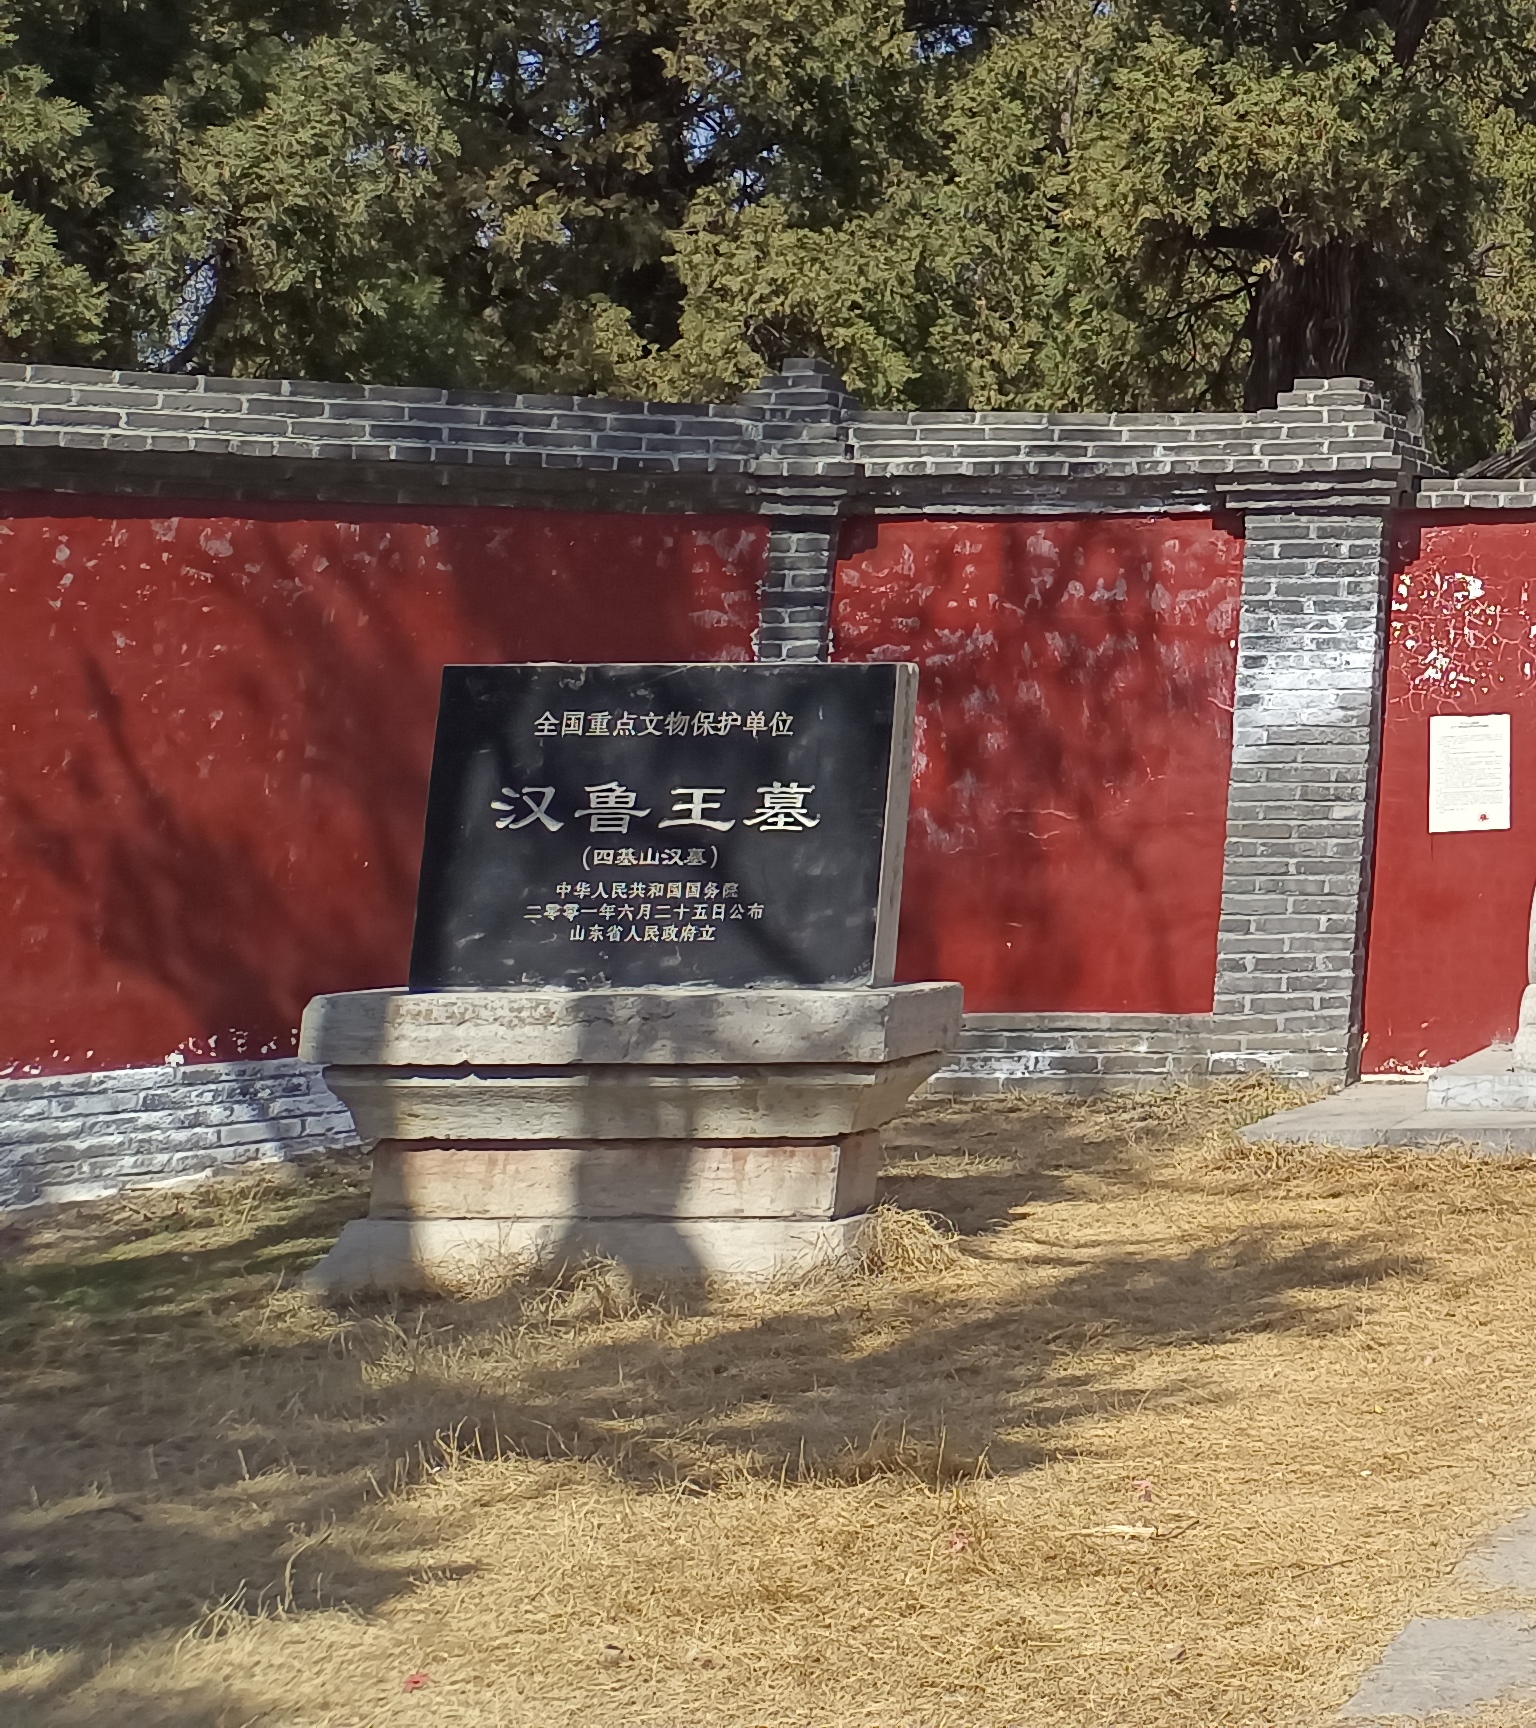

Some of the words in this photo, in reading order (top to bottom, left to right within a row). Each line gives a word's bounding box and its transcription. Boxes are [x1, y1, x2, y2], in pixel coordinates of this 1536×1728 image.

[533, 710, 795, 738] 全国重点文物保护单位
[490, 780, 821, 834] 汉鲁王墓
[555, 881, 739, 900] 中华人民共和国国务院
[522, 902, 765, 921] 二零零一年六月二十五日公布
[569, 924, 717, 943] 山东省人民政府立
